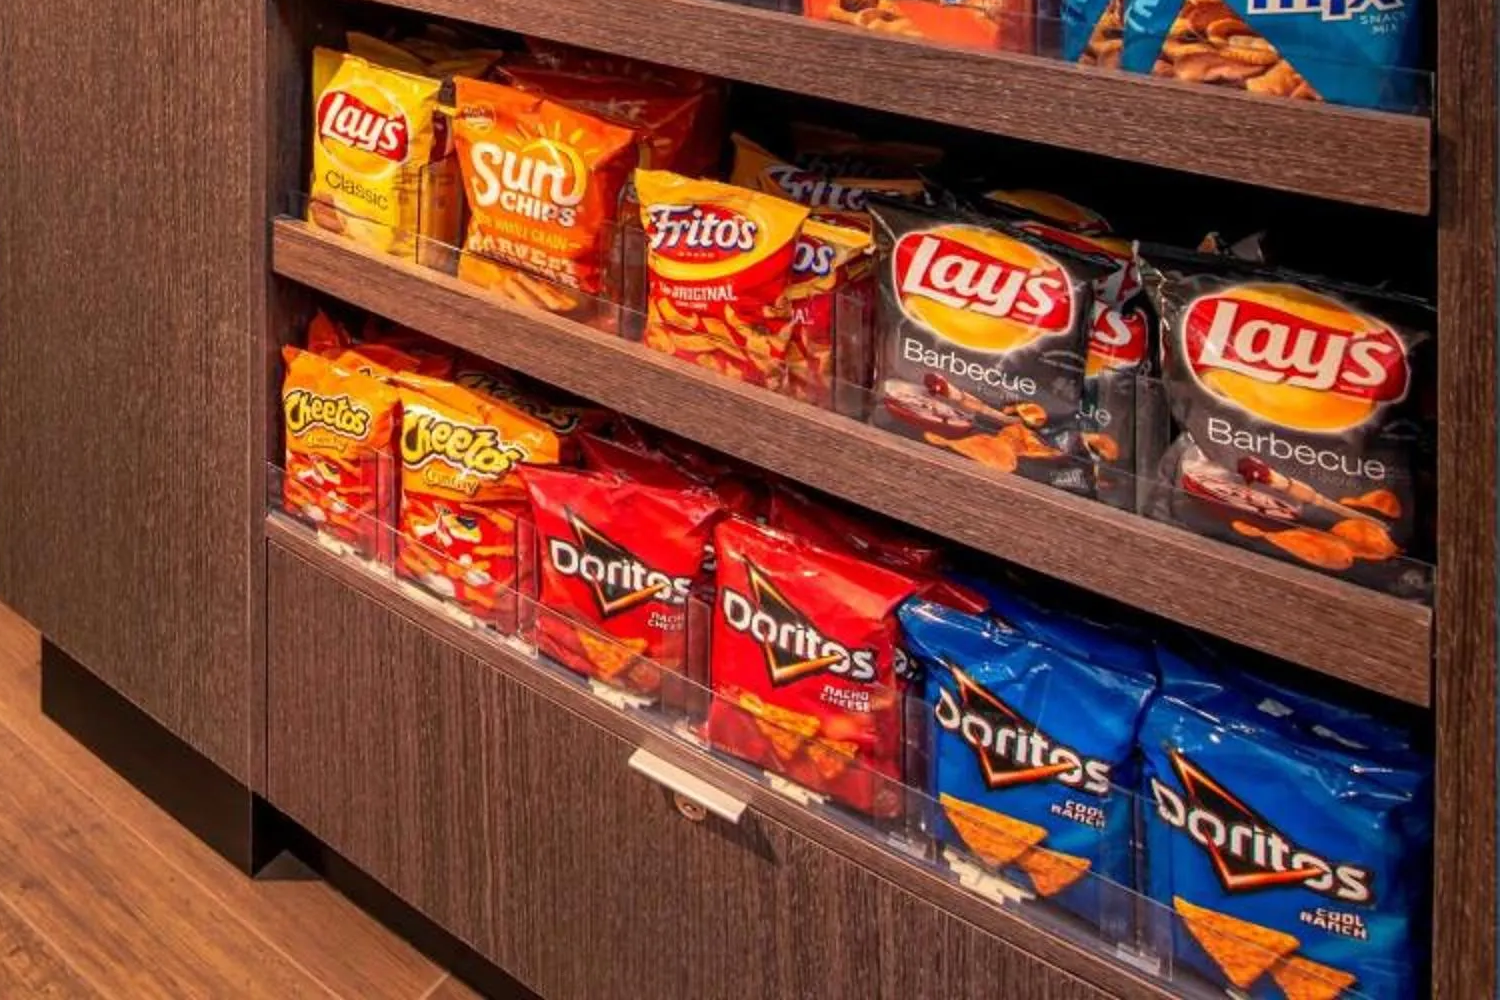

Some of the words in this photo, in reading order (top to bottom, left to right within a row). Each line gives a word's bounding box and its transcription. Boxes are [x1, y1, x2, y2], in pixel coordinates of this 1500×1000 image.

[320, 93, 406, 152] Lay's
[325, 170, 390, 211] Classic
[471, 140, 587, 207] Sun
[501, 190, 578, 229] CHIPS
[649, 203, 757, 250] Fritos
[902, 236, 1063, 318] Lay's
[903, 336, 1037, 396] Barbecue
[285, 390, 371, 437] Cheetos
[403, 410, 528, 476] Cheetos
[1208, 416, 1386, 482] Barbecue
[550, 538, 691, 605] Doritos
[721, 588, 876, 683] Doritos
[819, 692, 872, 713] CHEESE
[822, 684, 870, 701] NACHO
[935, 686, 1111, 794] Doritos
[1050, 803, 1107, 829] RANCH
[1065, 800, 1106, 819] COOL
[1151, 777, 1370, 901] Doritos
[1299, 909, 1367, 940] RANCH
[1316, 906, 1365, 928] COOL
